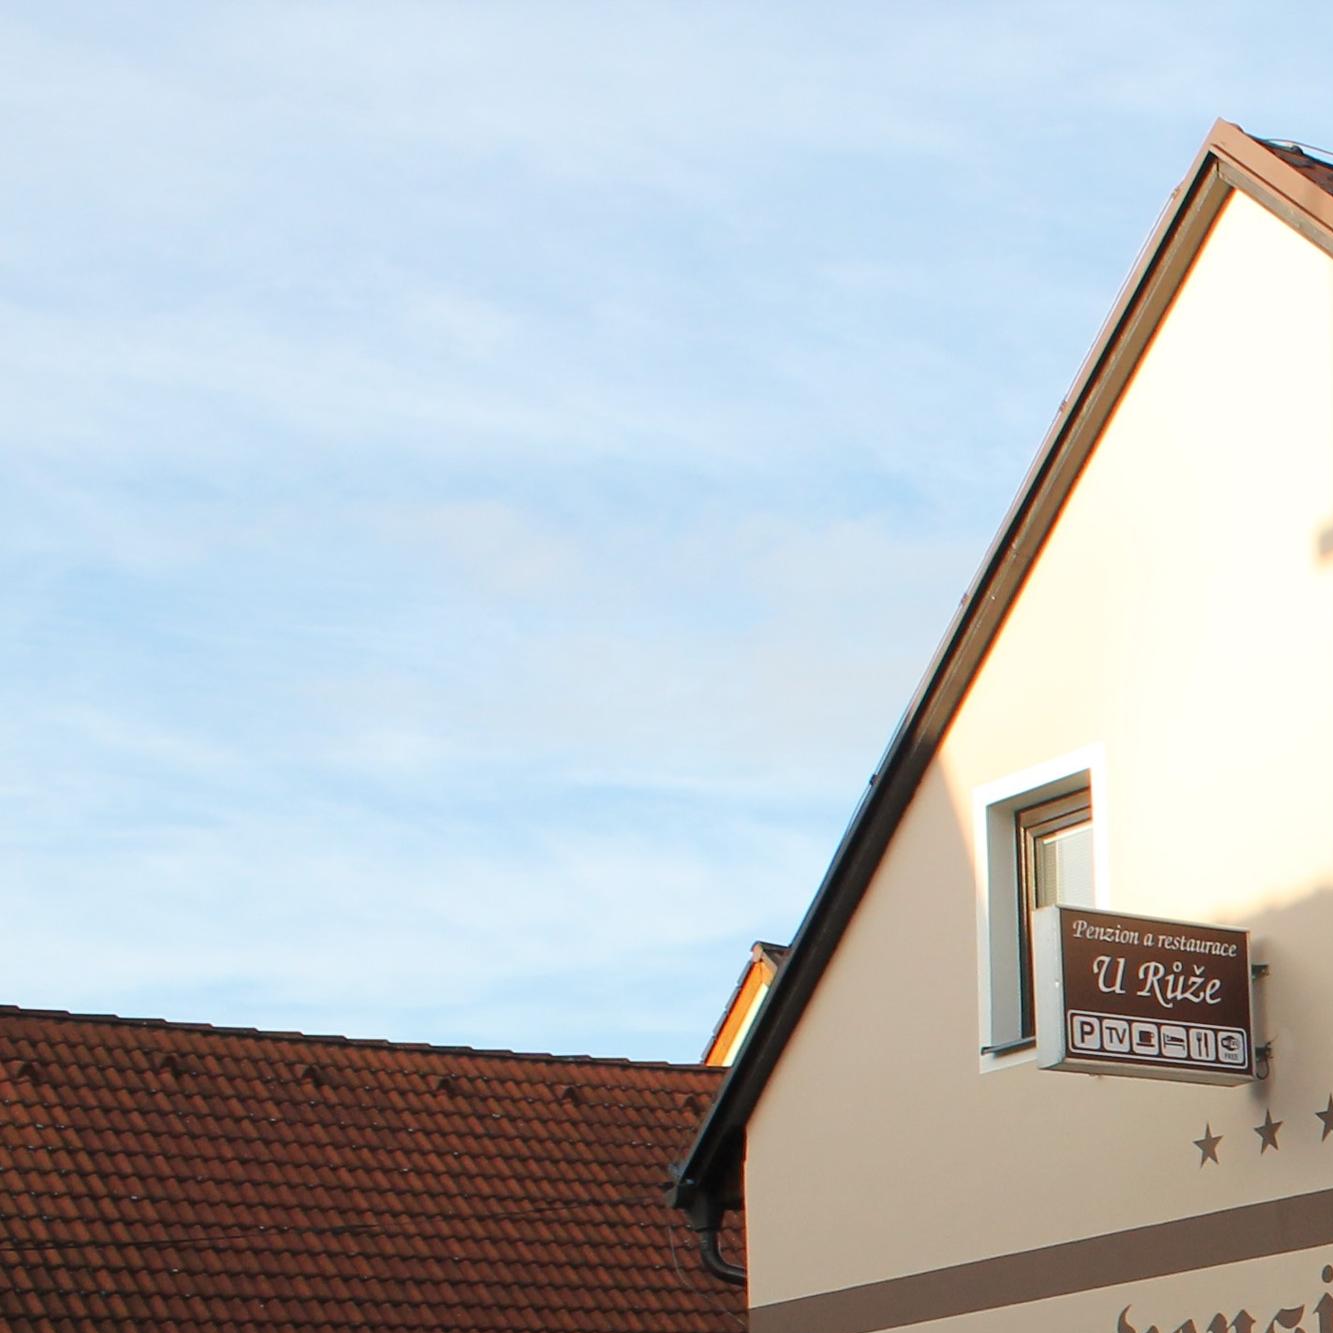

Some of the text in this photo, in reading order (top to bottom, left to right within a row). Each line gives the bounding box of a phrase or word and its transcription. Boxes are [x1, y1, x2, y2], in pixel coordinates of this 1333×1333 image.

[1072, 919, 1238, 958] Penzion a restaurace
[1093, 955, 1222, 1008] U Růže
[1080, 1020, 1127, 1045] P TV
